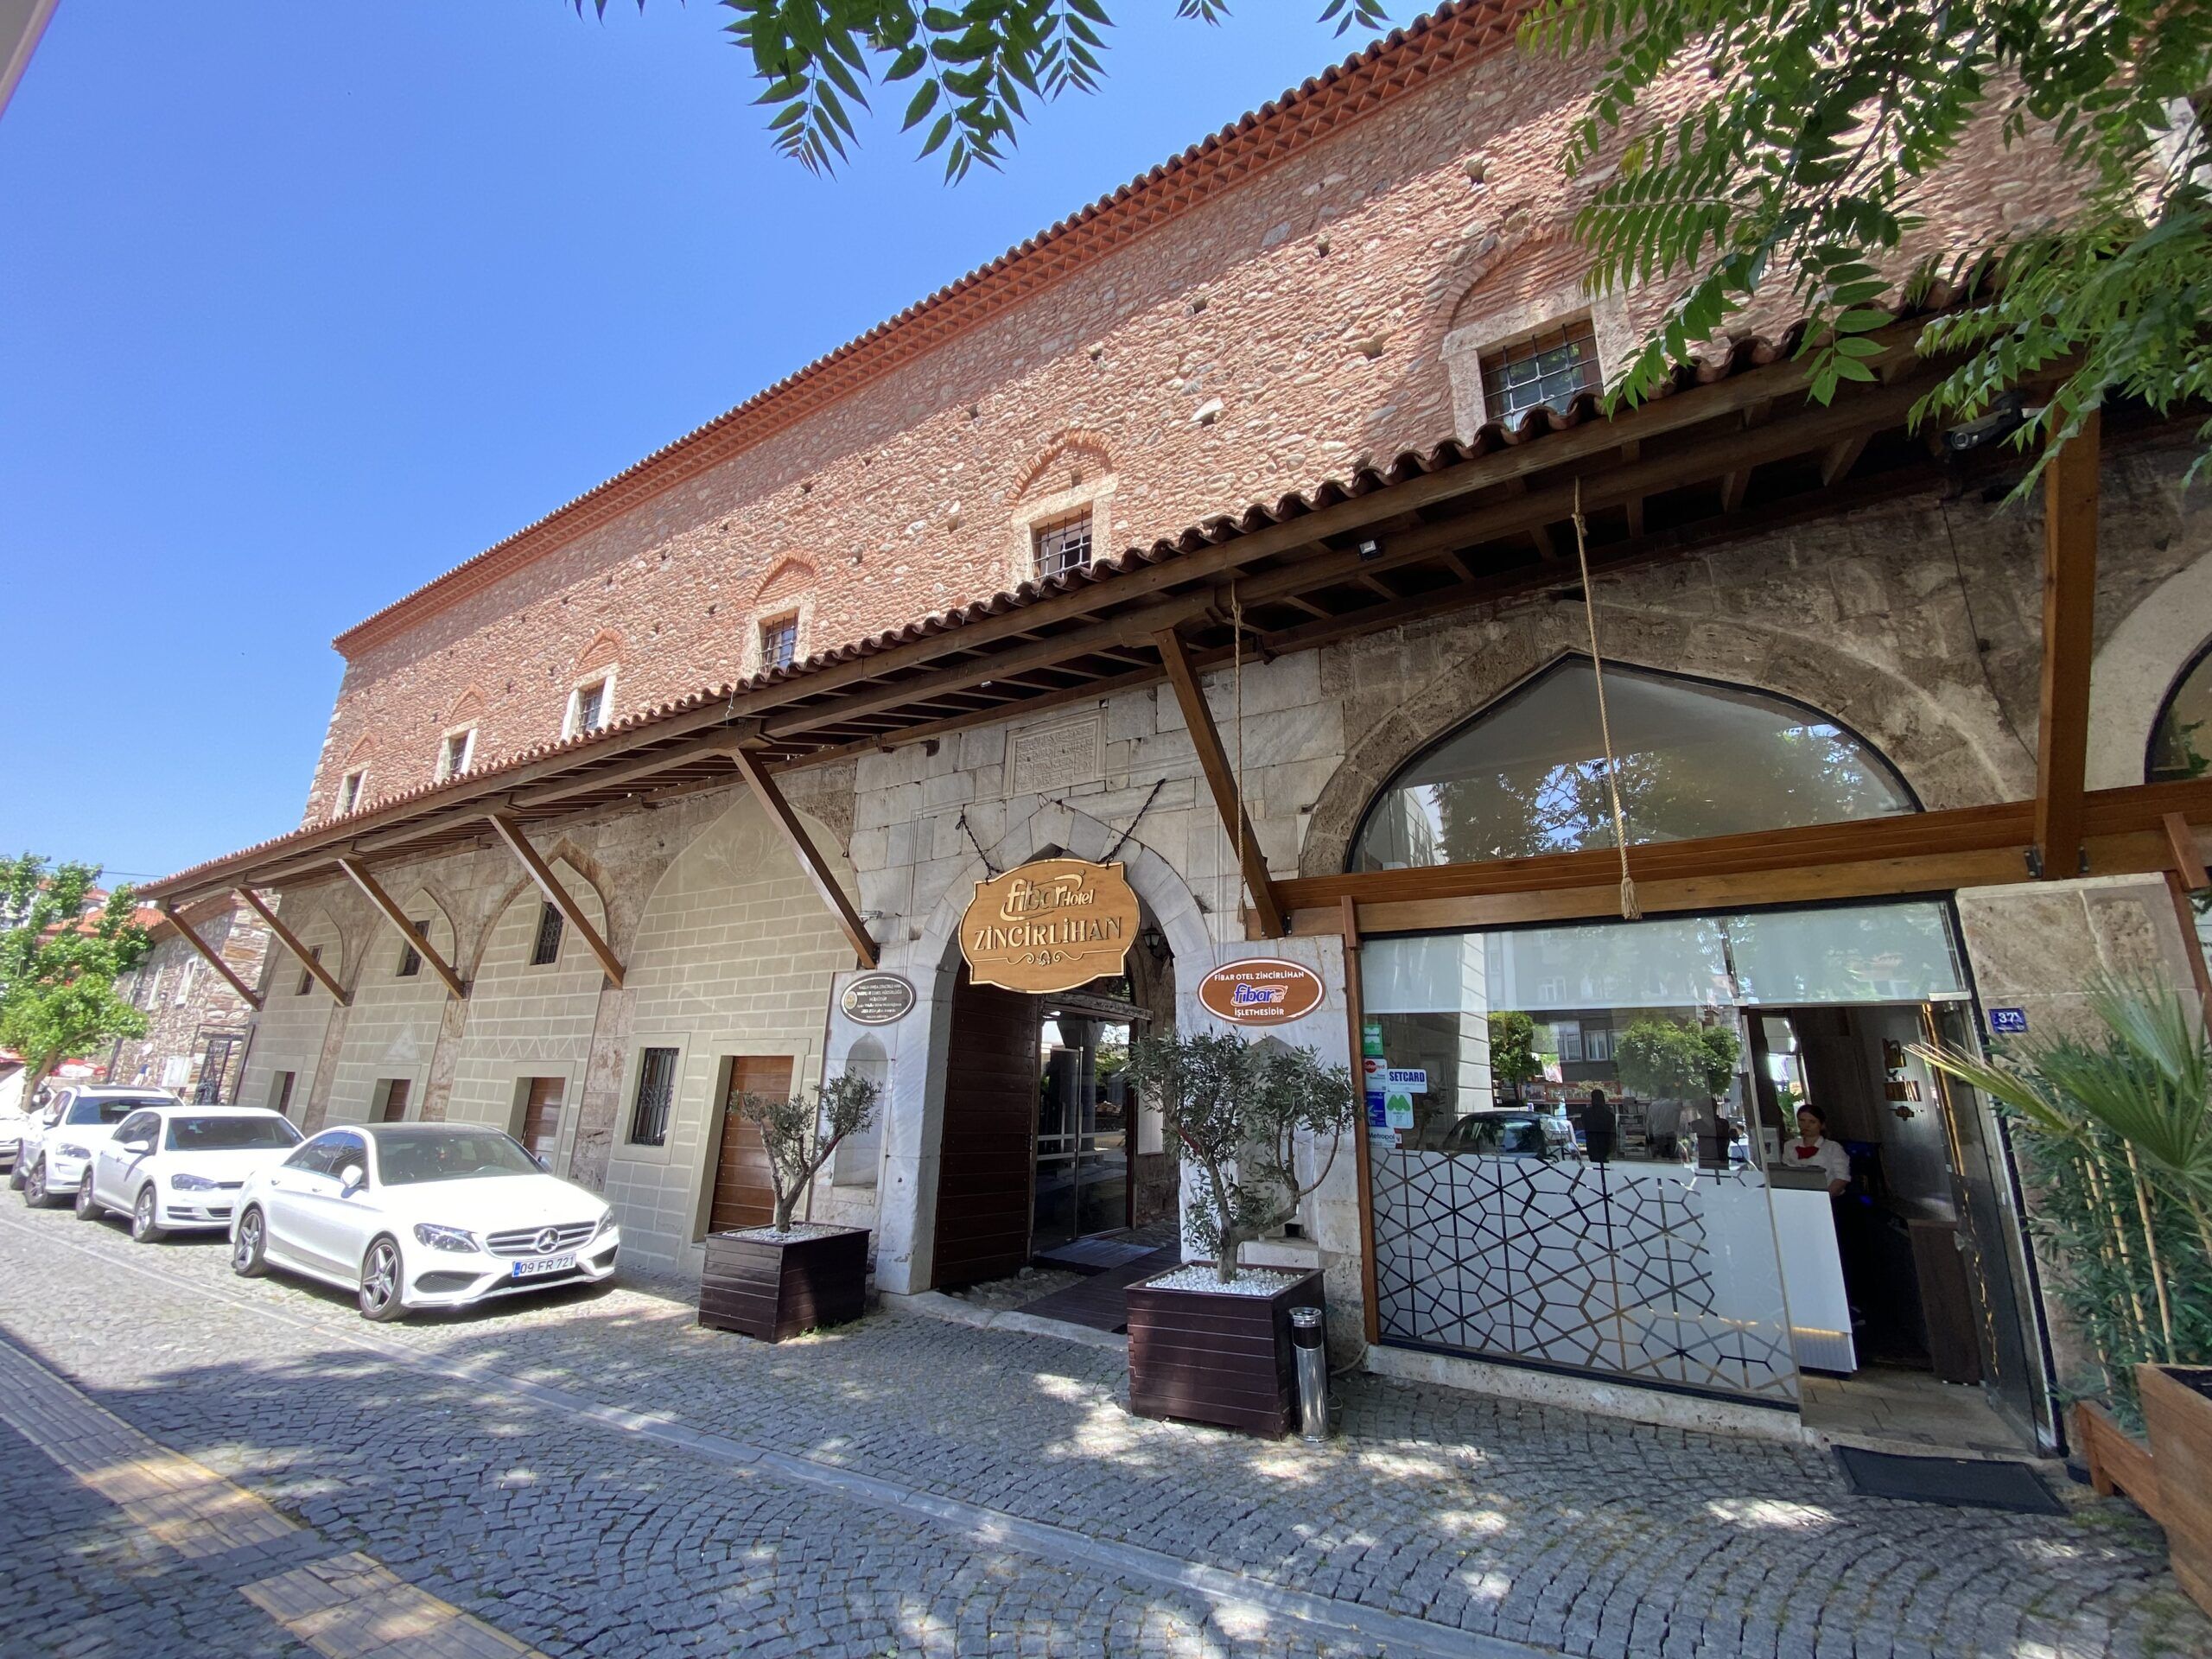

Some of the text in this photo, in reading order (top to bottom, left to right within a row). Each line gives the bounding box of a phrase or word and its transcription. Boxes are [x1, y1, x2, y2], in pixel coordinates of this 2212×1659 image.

[1062, 889, 1095, 907] Hotel
[974, 916, 1122, 951] ZİNCİRLİHAN
[1214, 973, 1235, 982] FİBAR
[1255, 969, 1305, 980] ZİNCİRLİHAN
[1235, 983, 1274, 1003] fibar
[1234, 1007, 1285, 1018] İŞLETMESİDİR
[1389, 1071, 1425, 1083] SETCARD
[520, 1256, 574, 1274] 09 FR 721
